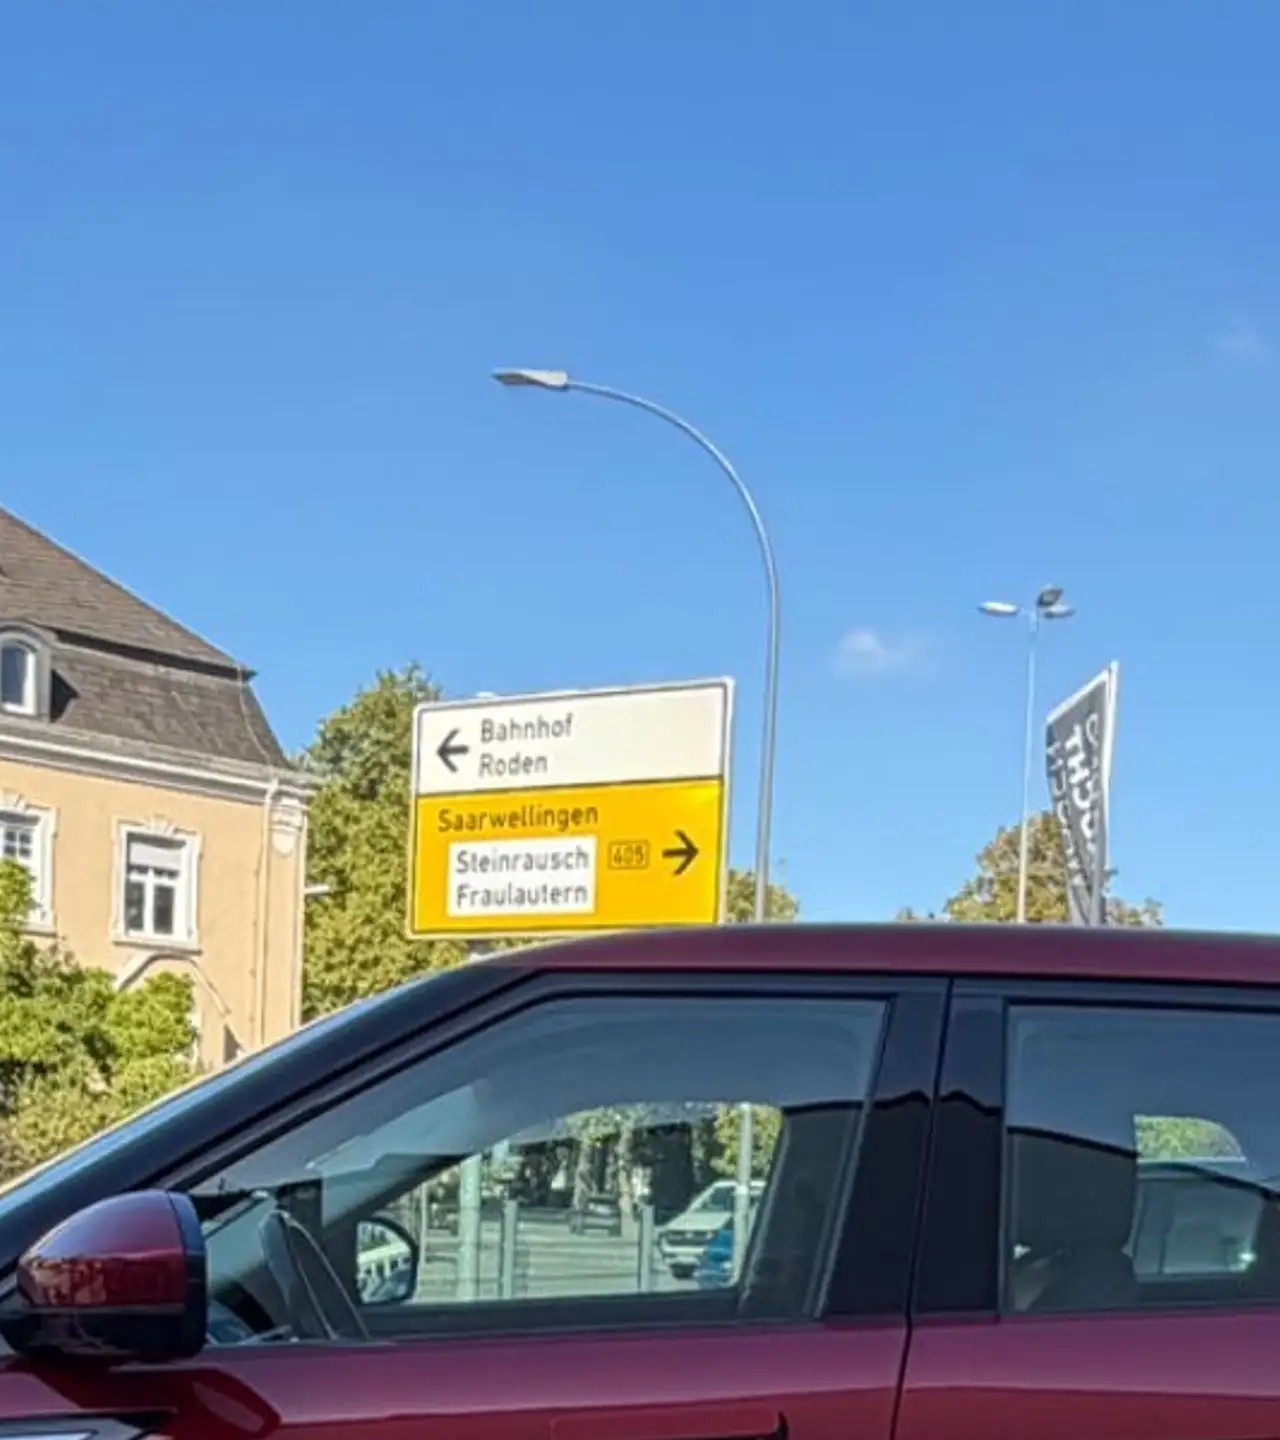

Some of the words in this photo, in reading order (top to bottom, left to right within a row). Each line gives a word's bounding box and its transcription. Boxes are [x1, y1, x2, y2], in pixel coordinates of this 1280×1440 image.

[480, 713, 573, 743] Bahnhof
[479, 753, 548, 777] Roden
[437, 805, 598, 833] Saarwellingen
[455, 847, 589, 874] Steinrausch
[456, 883, 588, 909] Fraulautern
